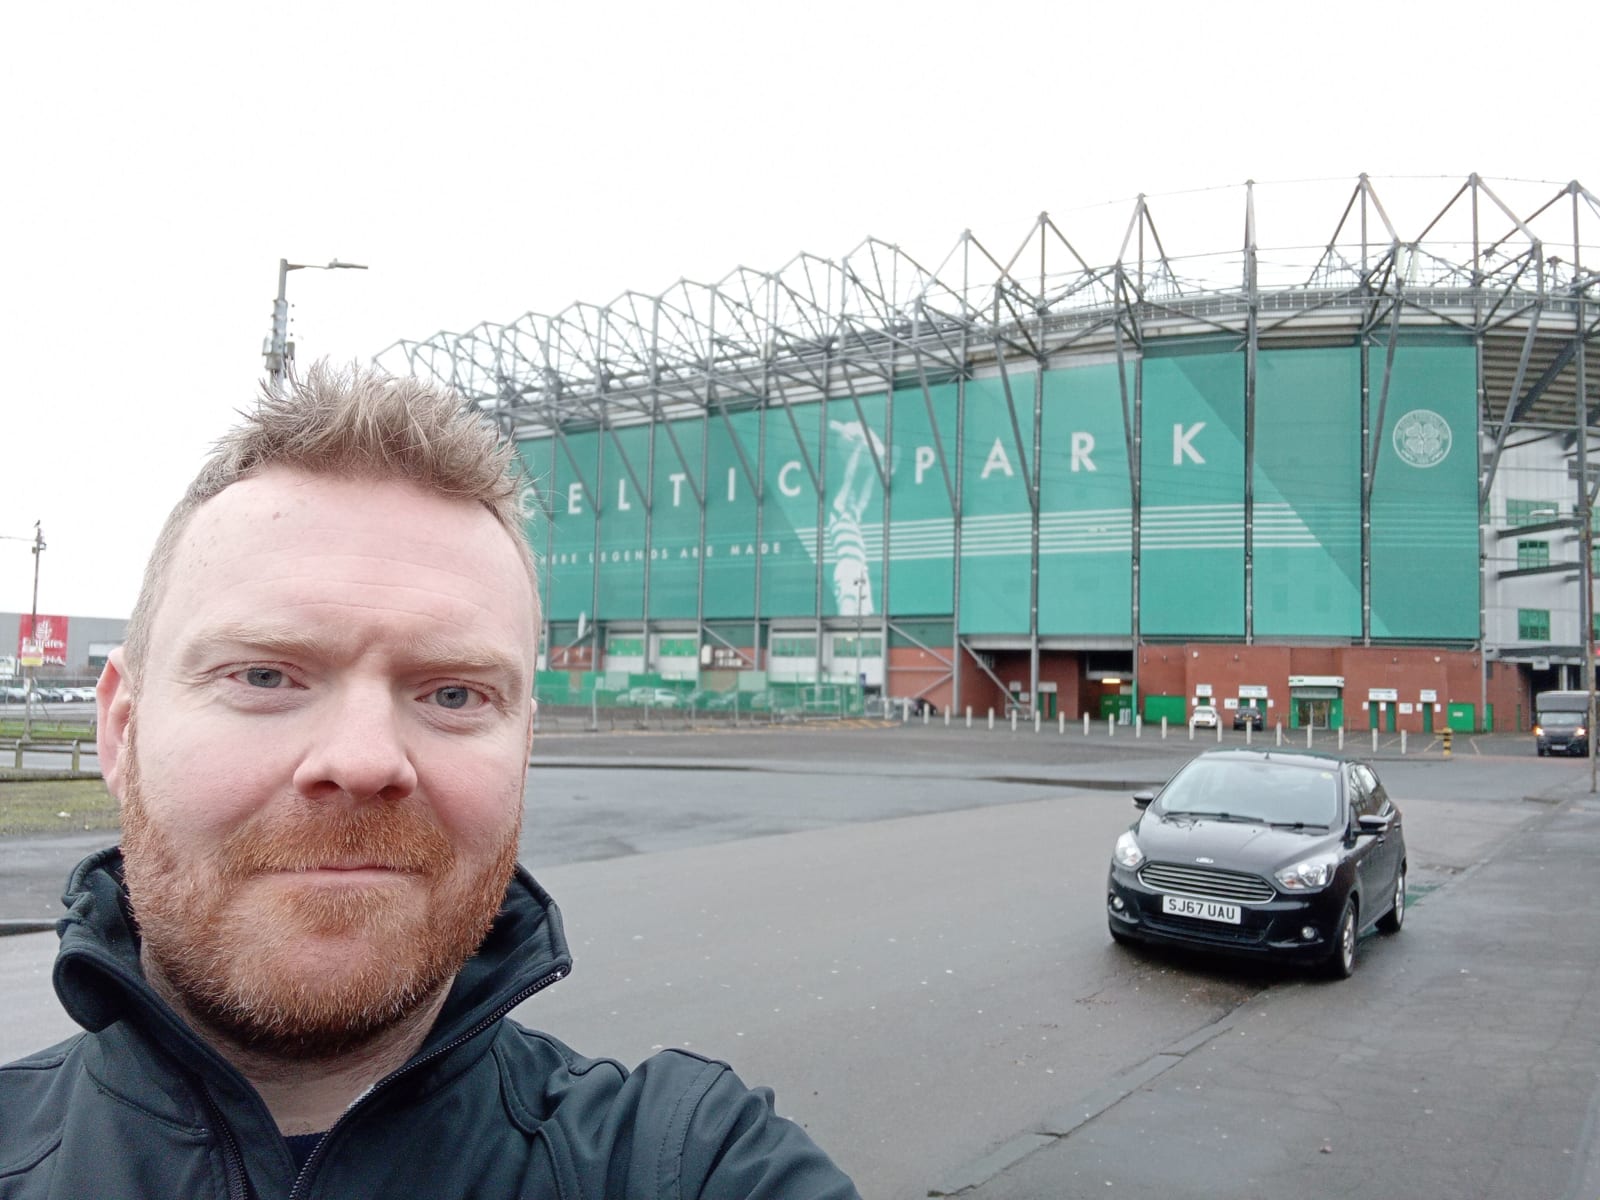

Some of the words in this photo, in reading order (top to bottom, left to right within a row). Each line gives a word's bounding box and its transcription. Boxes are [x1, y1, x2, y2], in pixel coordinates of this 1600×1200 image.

[519, 461, 802, 518] CELTIC
[914, 422, 1207, 484] PARK
[588, 548, 669, 563] LEGENDS
[680, 545, 713, 558] ARE
[730, 542, 781, 556] MADE
[1168, 898, 1204, 915] SJ67
[1207, 904, 1235, 920] UAU
